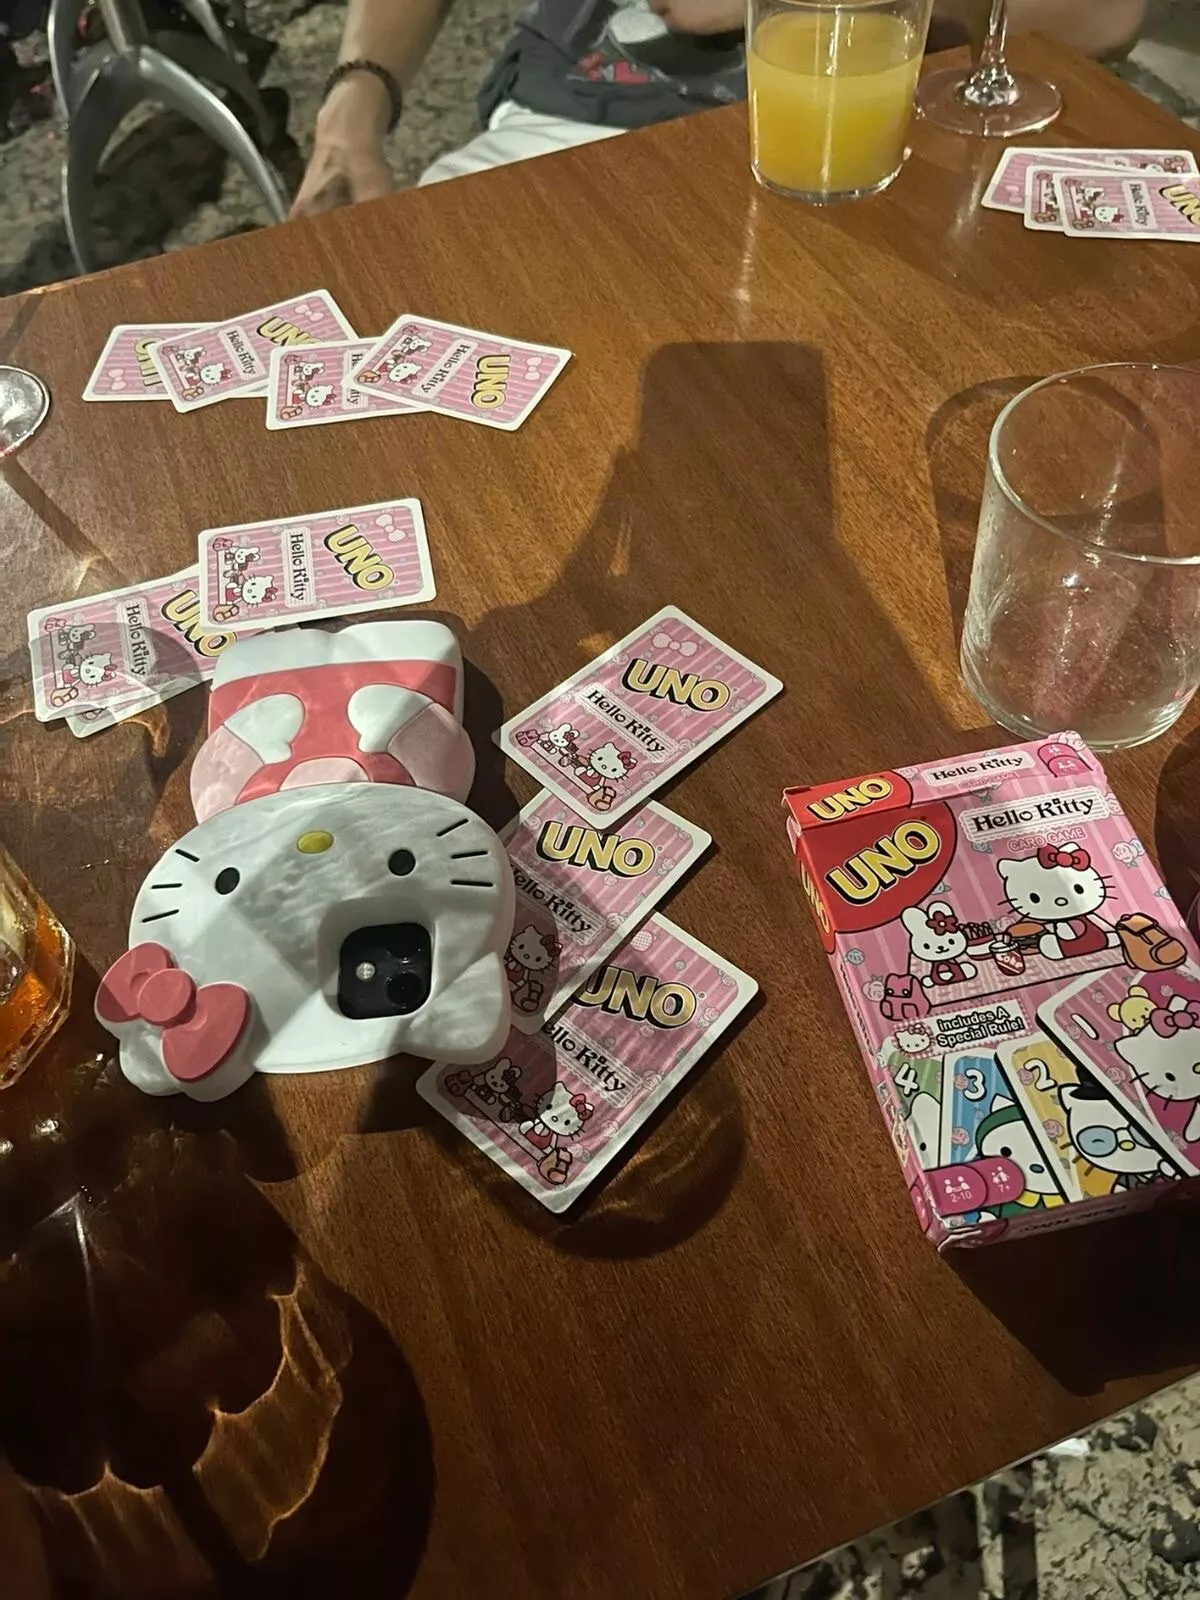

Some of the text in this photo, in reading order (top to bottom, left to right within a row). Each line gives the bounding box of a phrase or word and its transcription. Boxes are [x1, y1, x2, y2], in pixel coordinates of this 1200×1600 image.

[227, 330, 256, 375] Hello Kitty
[257, 317, 325, 347] UN
[421, 344, 471, 393] Hello Kitty
[471, 354, 511, 409] UNO
[290, 533, 309, 600] Hello Kitty
[324, 524, 394, 591] UNO
[126, 604, 150, 676] Hello Kitty
[622, 658, 730, 712] UNO
[587, 689, 665, 752] Hello Kitty
[933, 757, 1023, 781] Hello Kitty
[808, 778, 893, 820] UNO
[972, 798, 1093, 832] Hello Kitty
[536, 820, 655, 877] UNO
[1008, 826, 1086, 852] CARD GAME
[825, 820, 940, 905] UNO
[511, 866, 591, 932] ello Kitty
[936, 1016, 1025, 1048] Special Rule!
[997, 1006, 1011, 1020] A
[543, 1022, 626, 1092] ello Kitty
[894, 1062, 919, 1097] 4
[1023, 1058, 1057, 1091] 2
[964, 1068, 987, 1101] 3
[950, 1190, 973, 1203] 2-10
